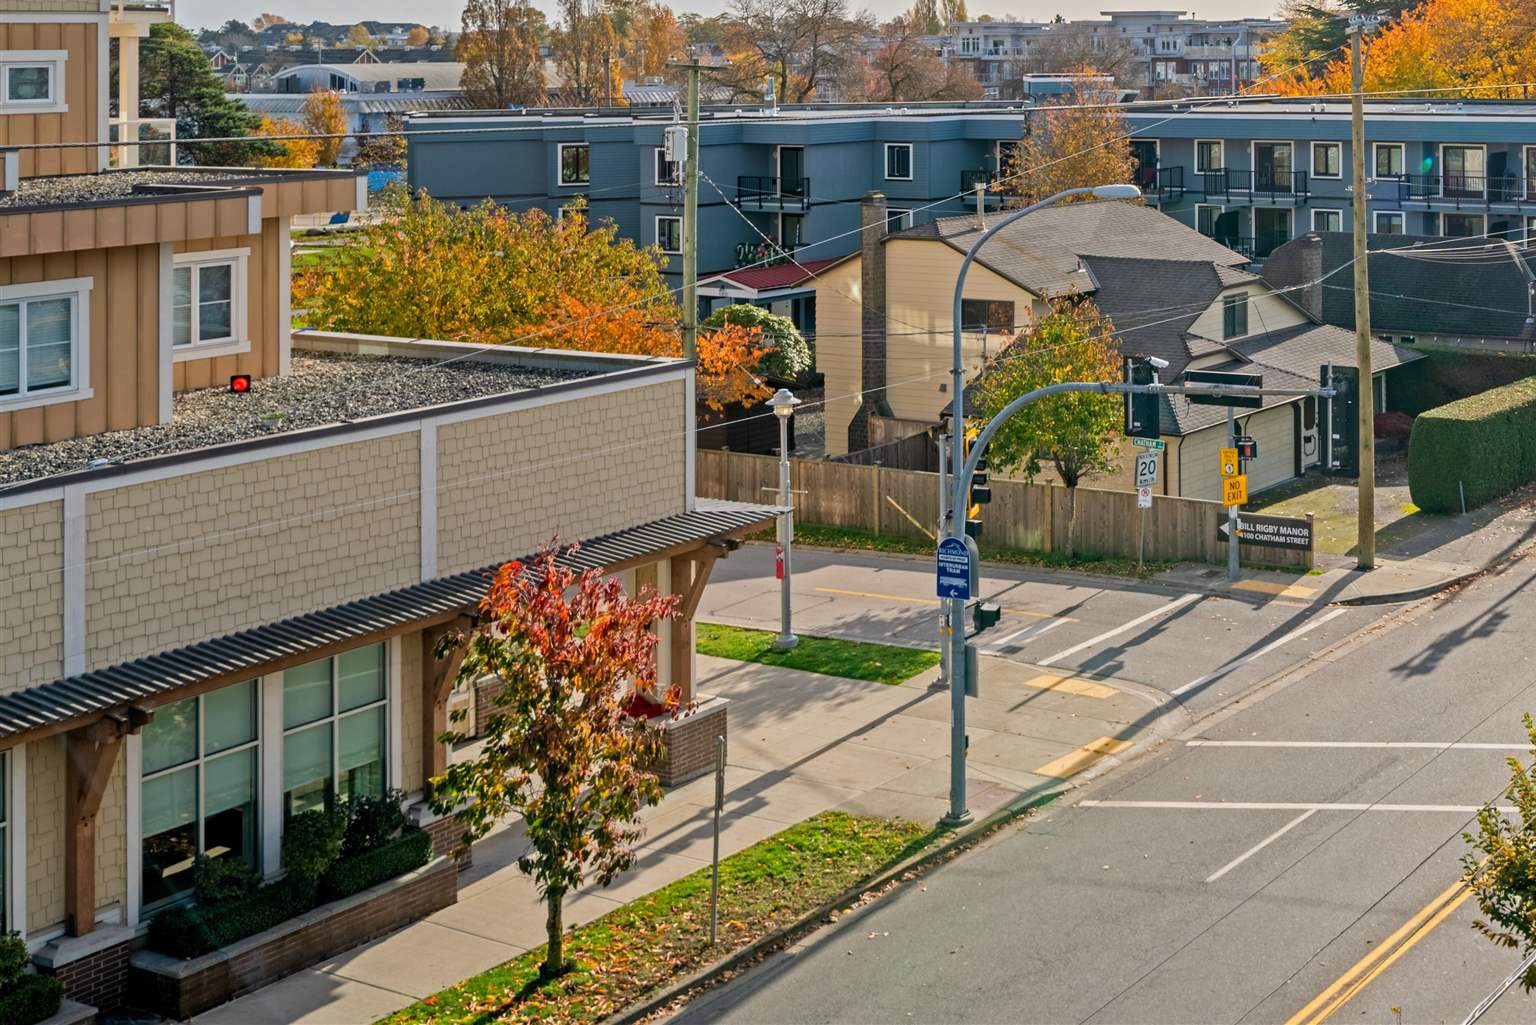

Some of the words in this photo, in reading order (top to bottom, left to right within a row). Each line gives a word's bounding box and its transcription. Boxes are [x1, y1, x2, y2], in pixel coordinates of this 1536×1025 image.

[1140, 460, 1156, 476] 20
[1230, 480, 1240, 490] NO
[1227, 490, 1242, 501] EXIT
[1241, 522, 1254, 531] BILL
[1256, 524, 1278, 533] RIGBY
[1279, 526, 1309, 536] MANOR
[1255, 533, 1285, 542] CHATHAM
[1286, 536, 1309, 545] STREET
